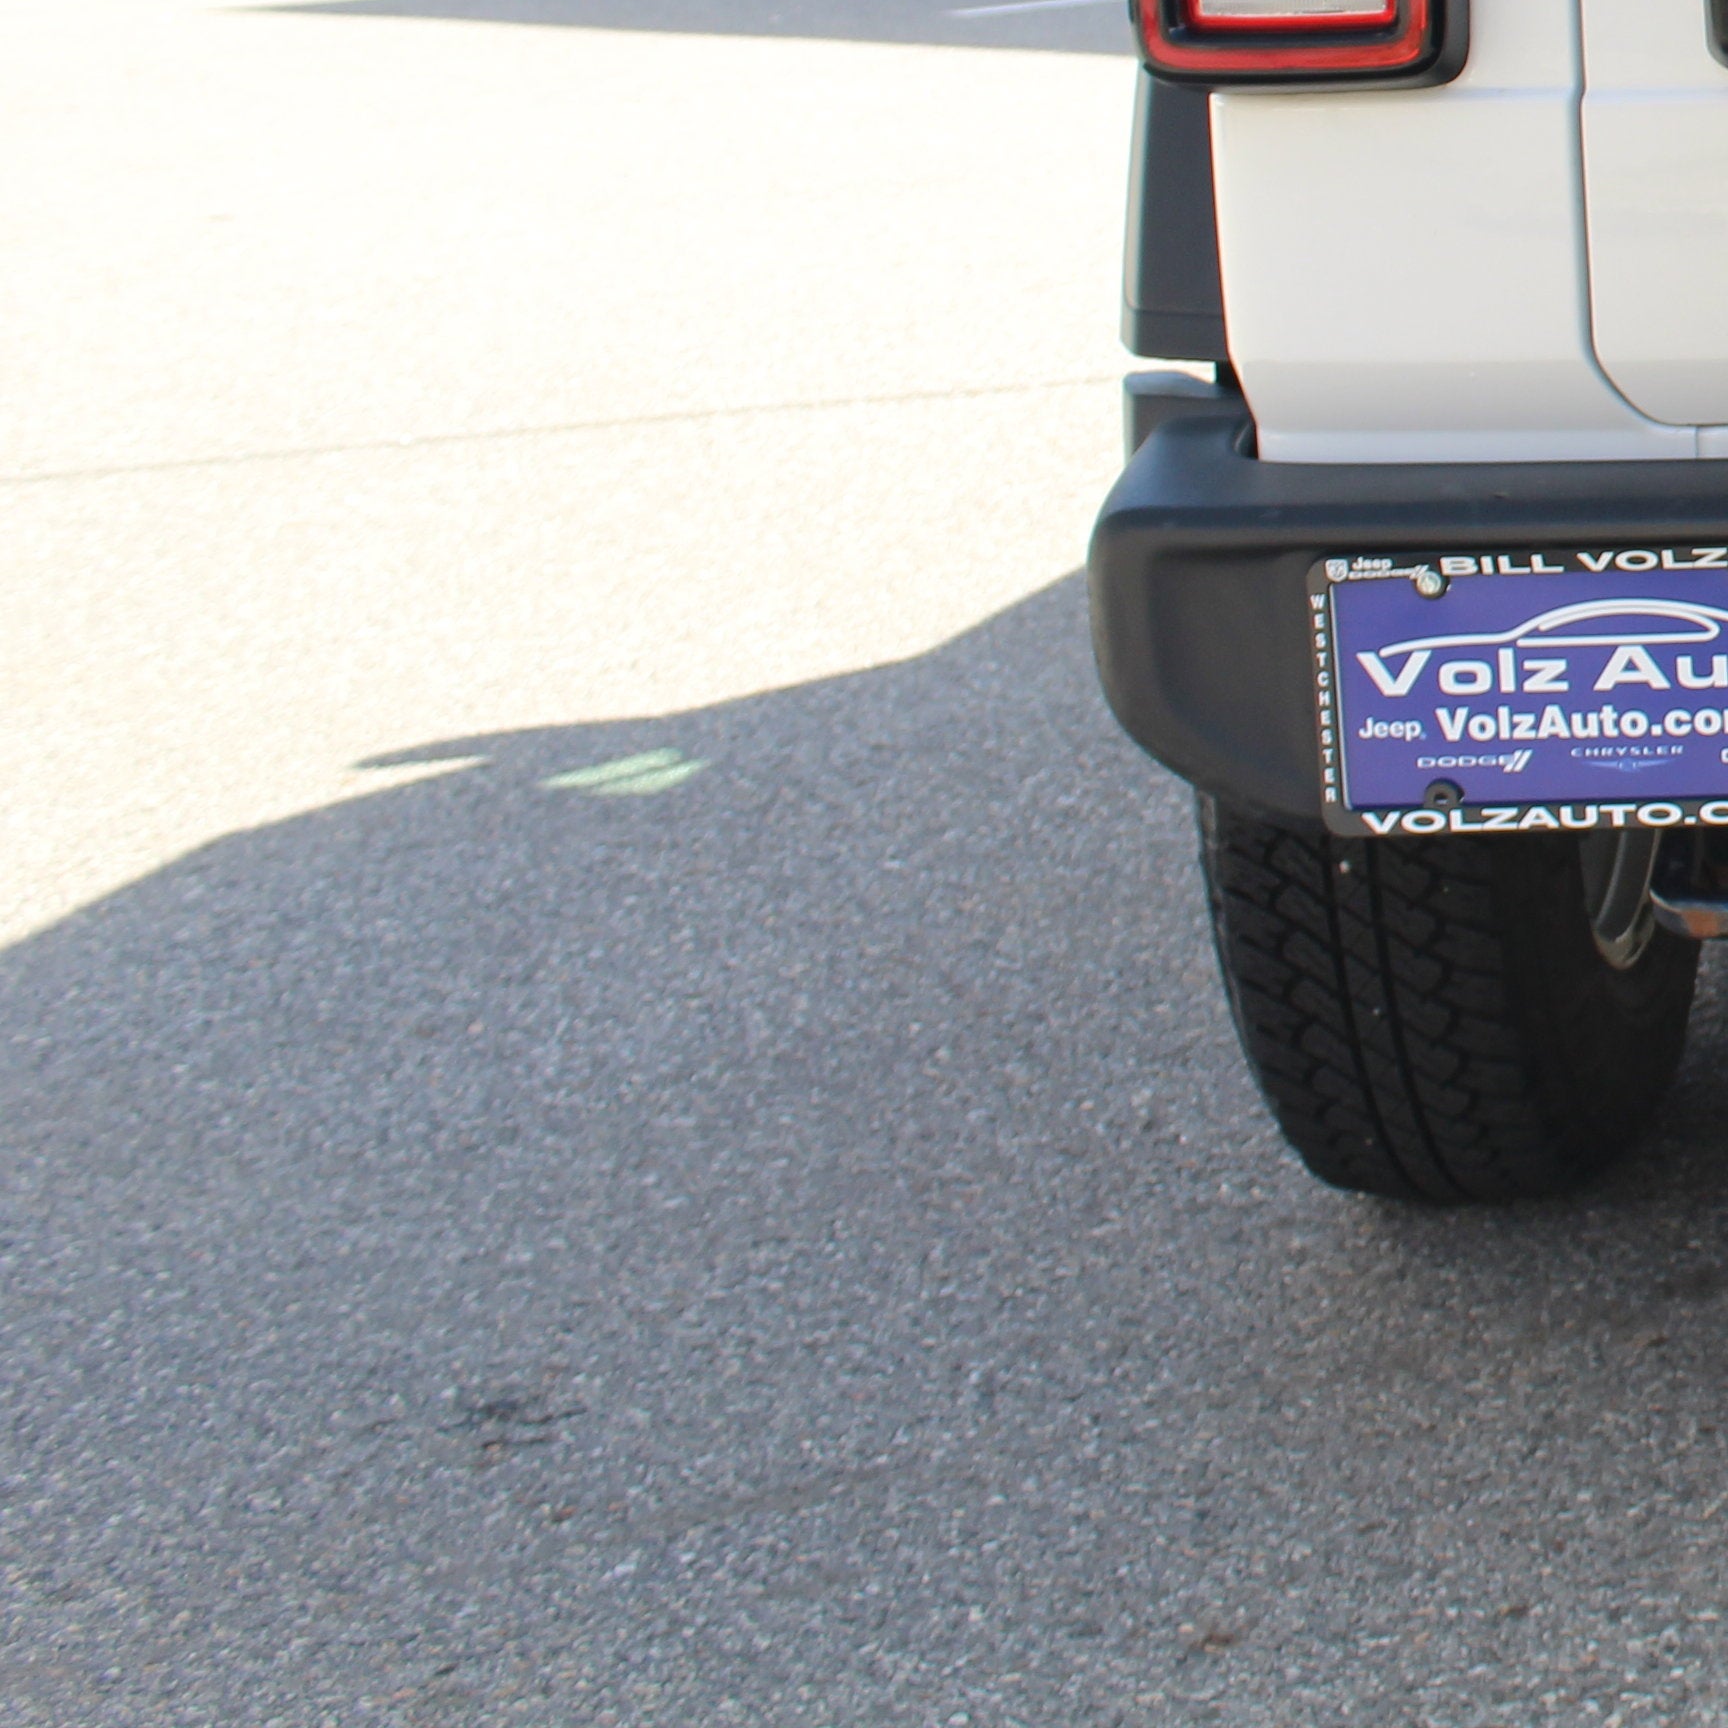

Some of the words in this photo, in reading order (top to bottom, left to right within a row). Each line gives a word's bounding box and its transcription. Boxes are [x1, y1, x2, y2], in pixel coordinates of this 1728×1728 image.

[1351, 556, 1393, 571] Jeep
[1440, 553, 1564, 576] BILL
[1577, 547, 1728, 572] VOLZ
[1356, 647, 1570, 697] Volz
[1310, 594, 1337, 804] WESTCHESTER
[1358, 717, 1422, 742] Jeep
[1416, 754, 1515, 769] DODGE
[1570, 744, 1685, 759] CHRYSLER
